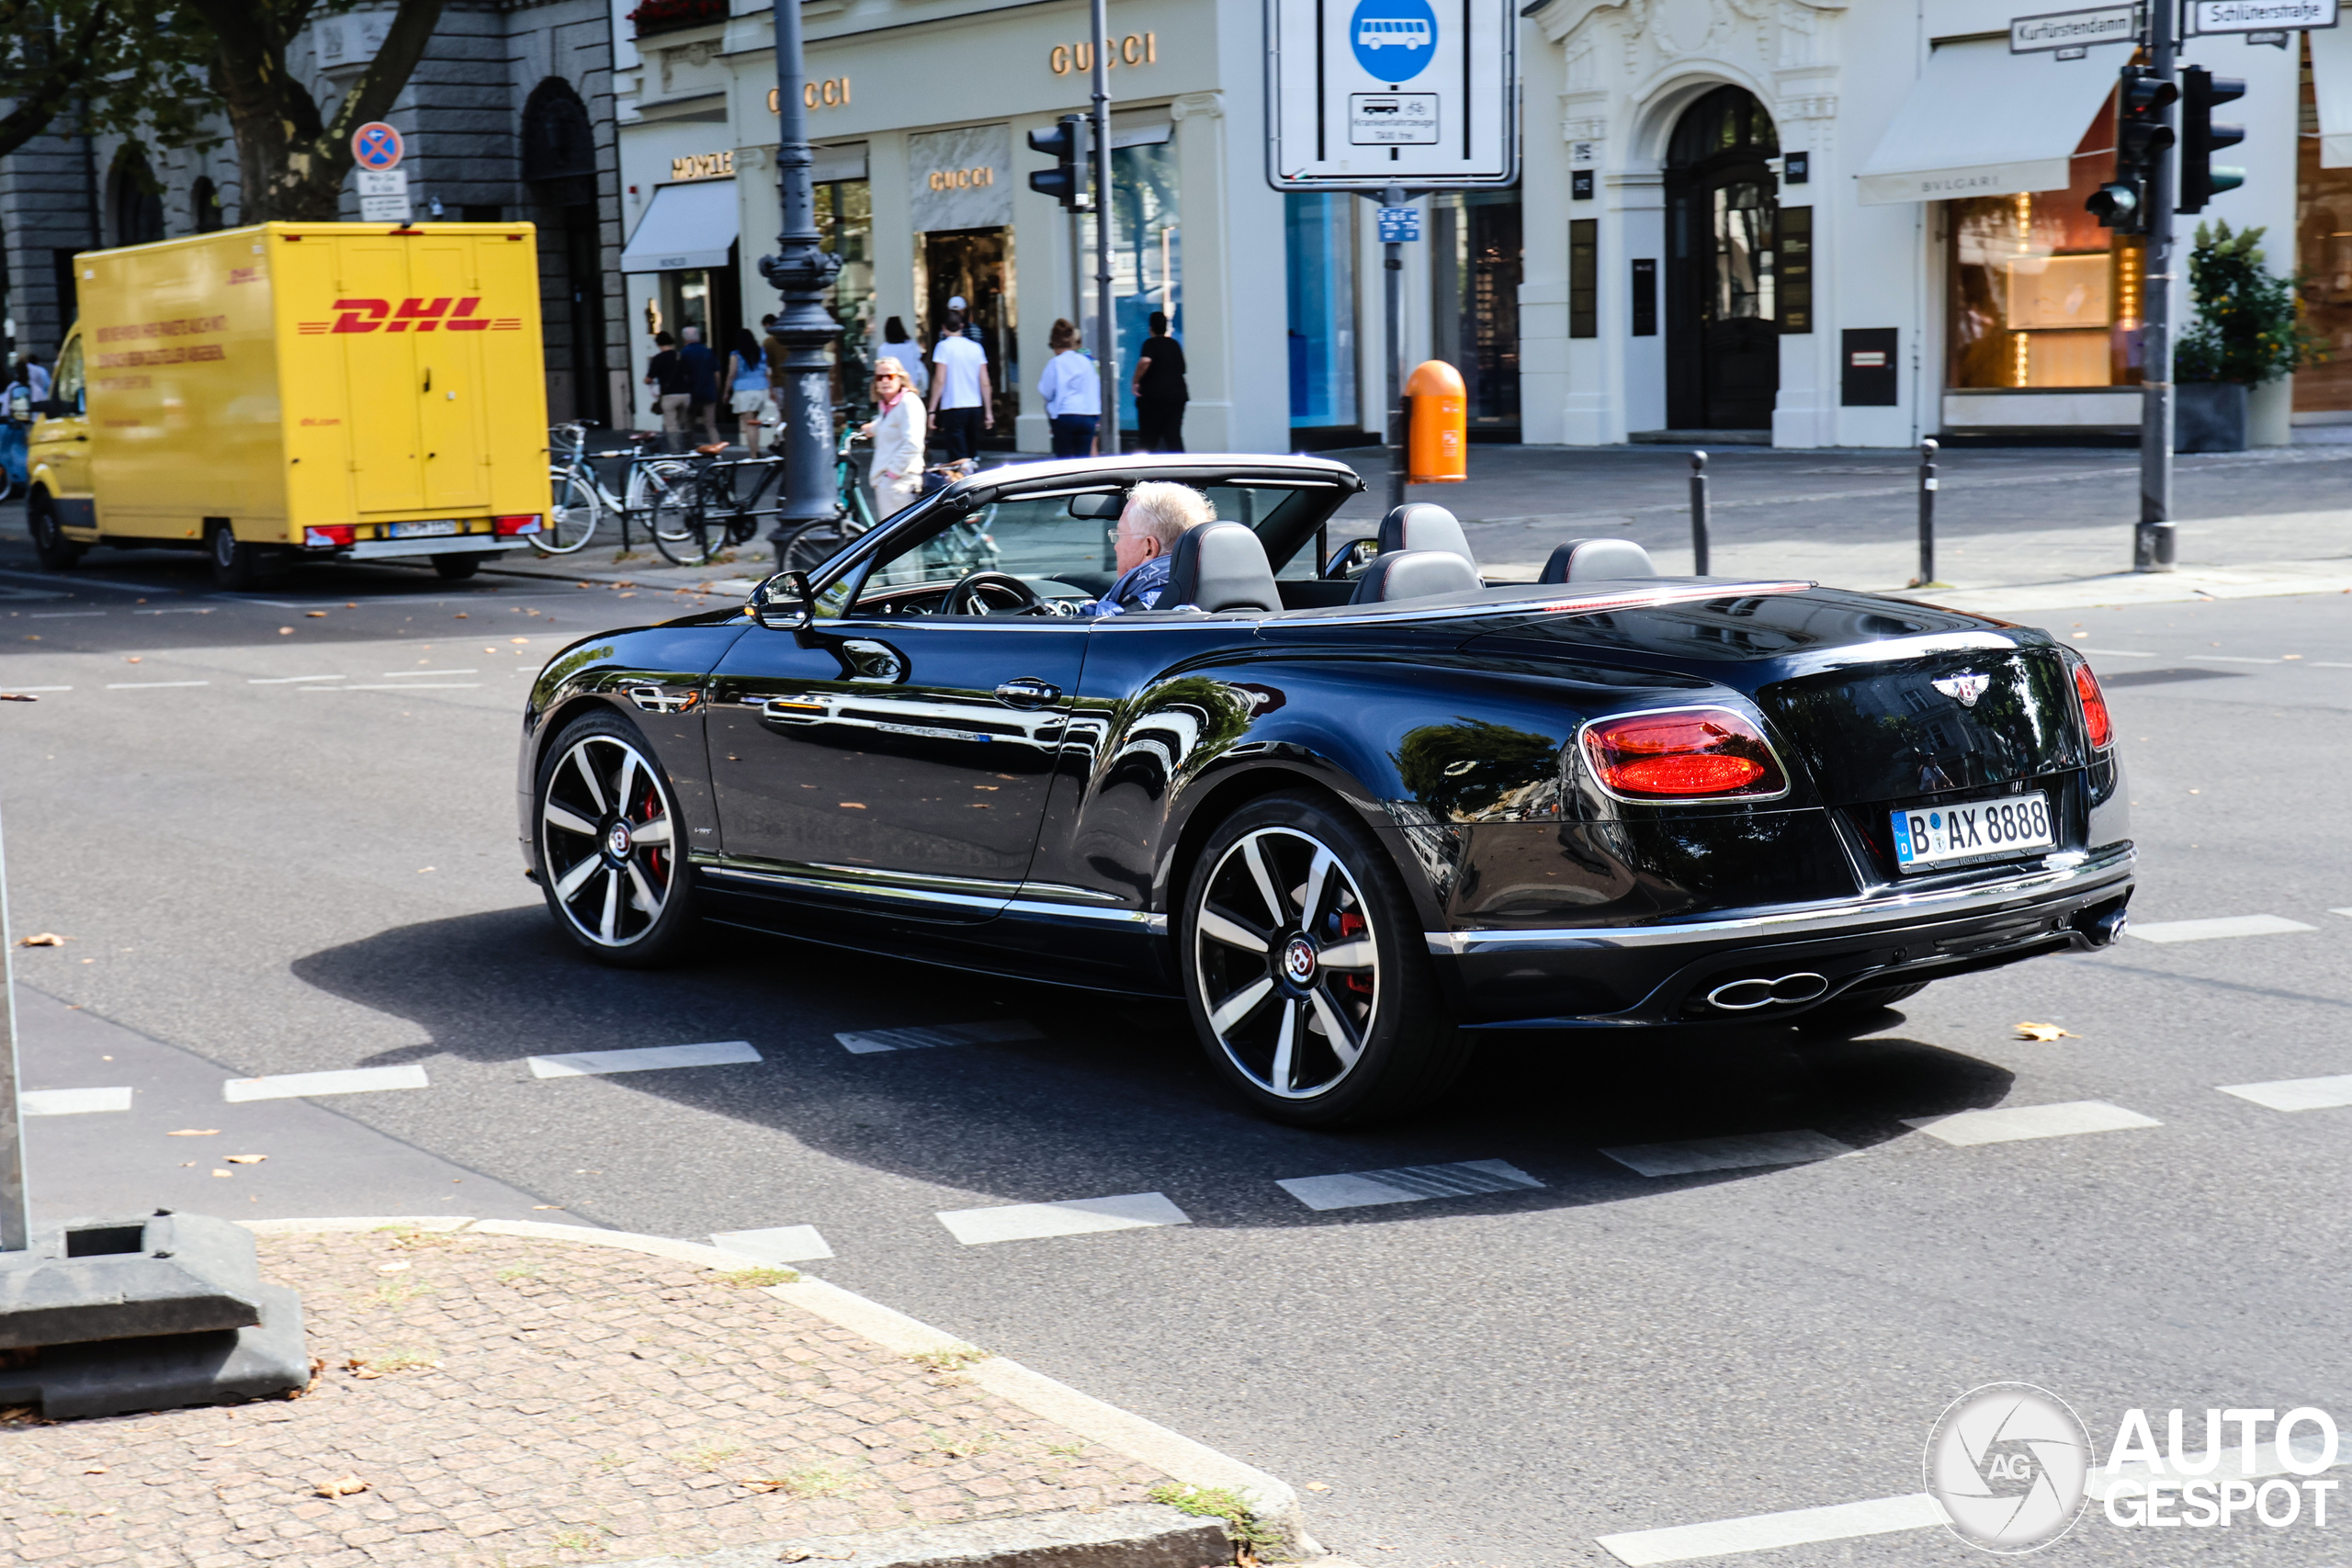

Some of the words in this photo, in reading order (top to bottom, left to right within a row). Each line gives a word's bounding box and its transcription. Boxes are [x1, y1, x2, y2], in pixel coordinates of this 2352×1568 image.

[2211, 1, 2322, 22] Schlüterstraße
[2018, 17, 2126, 40] Kurfürstendamm
[1051, 32, 1156, 75] GUCCI
[1353, 118, 1436, 128] Krankenfahrzeuge
[929, 166, 994, 191] GUCCI
[1921, 175, 1998, 192] BVLGARI
[330, 297, 492, 333] DHL
[300, 417, 341, 426] dhl.com
[1910, 816, 1929, 855] B
[1948, 808, 1983, 850] AX
[1985, 800, 2047, 843] 8888
[1901, 842, 1908, 855] D
